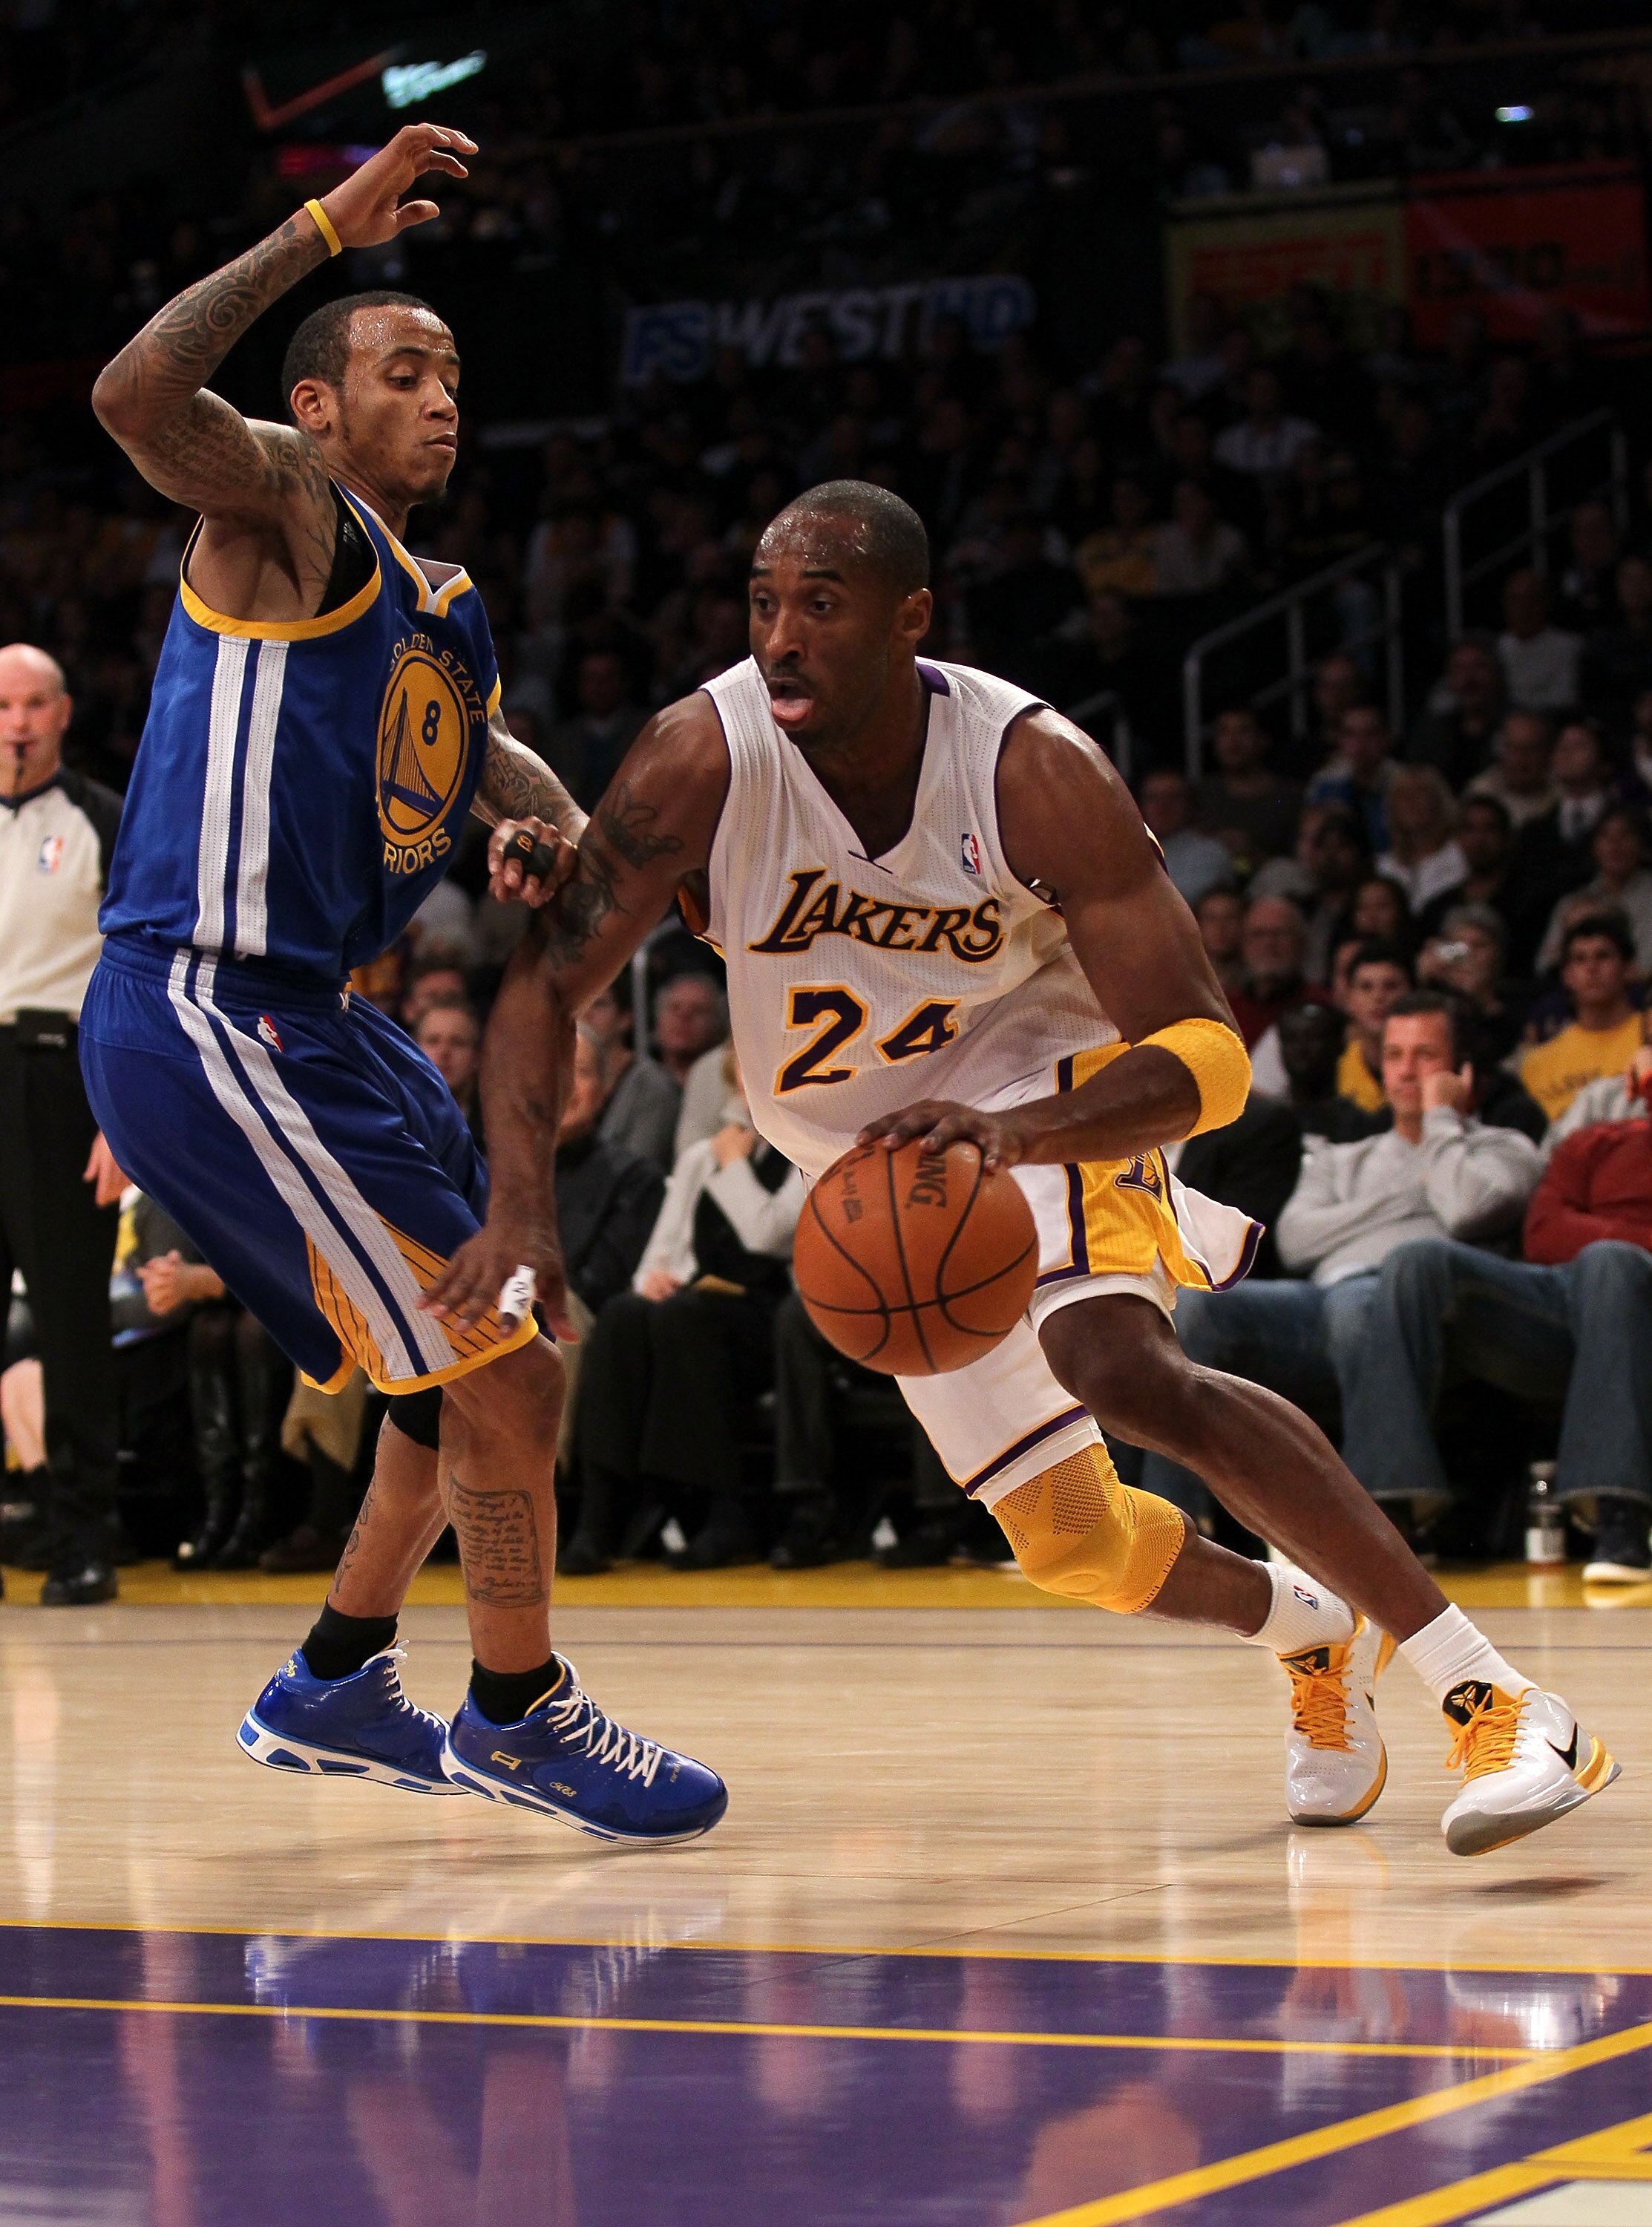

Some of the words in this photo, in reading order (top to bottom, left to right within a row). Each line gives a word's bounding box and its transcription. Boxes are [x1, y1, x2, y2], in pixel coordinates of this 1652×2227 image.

[422, 700, 441, 746] 8
[439, 650, 485, 725] STATE
[383, 828, 452, 874] RIORS
[747, 867, 1004, 963] LAKERS
[773, 984, 962, 1096] 24
